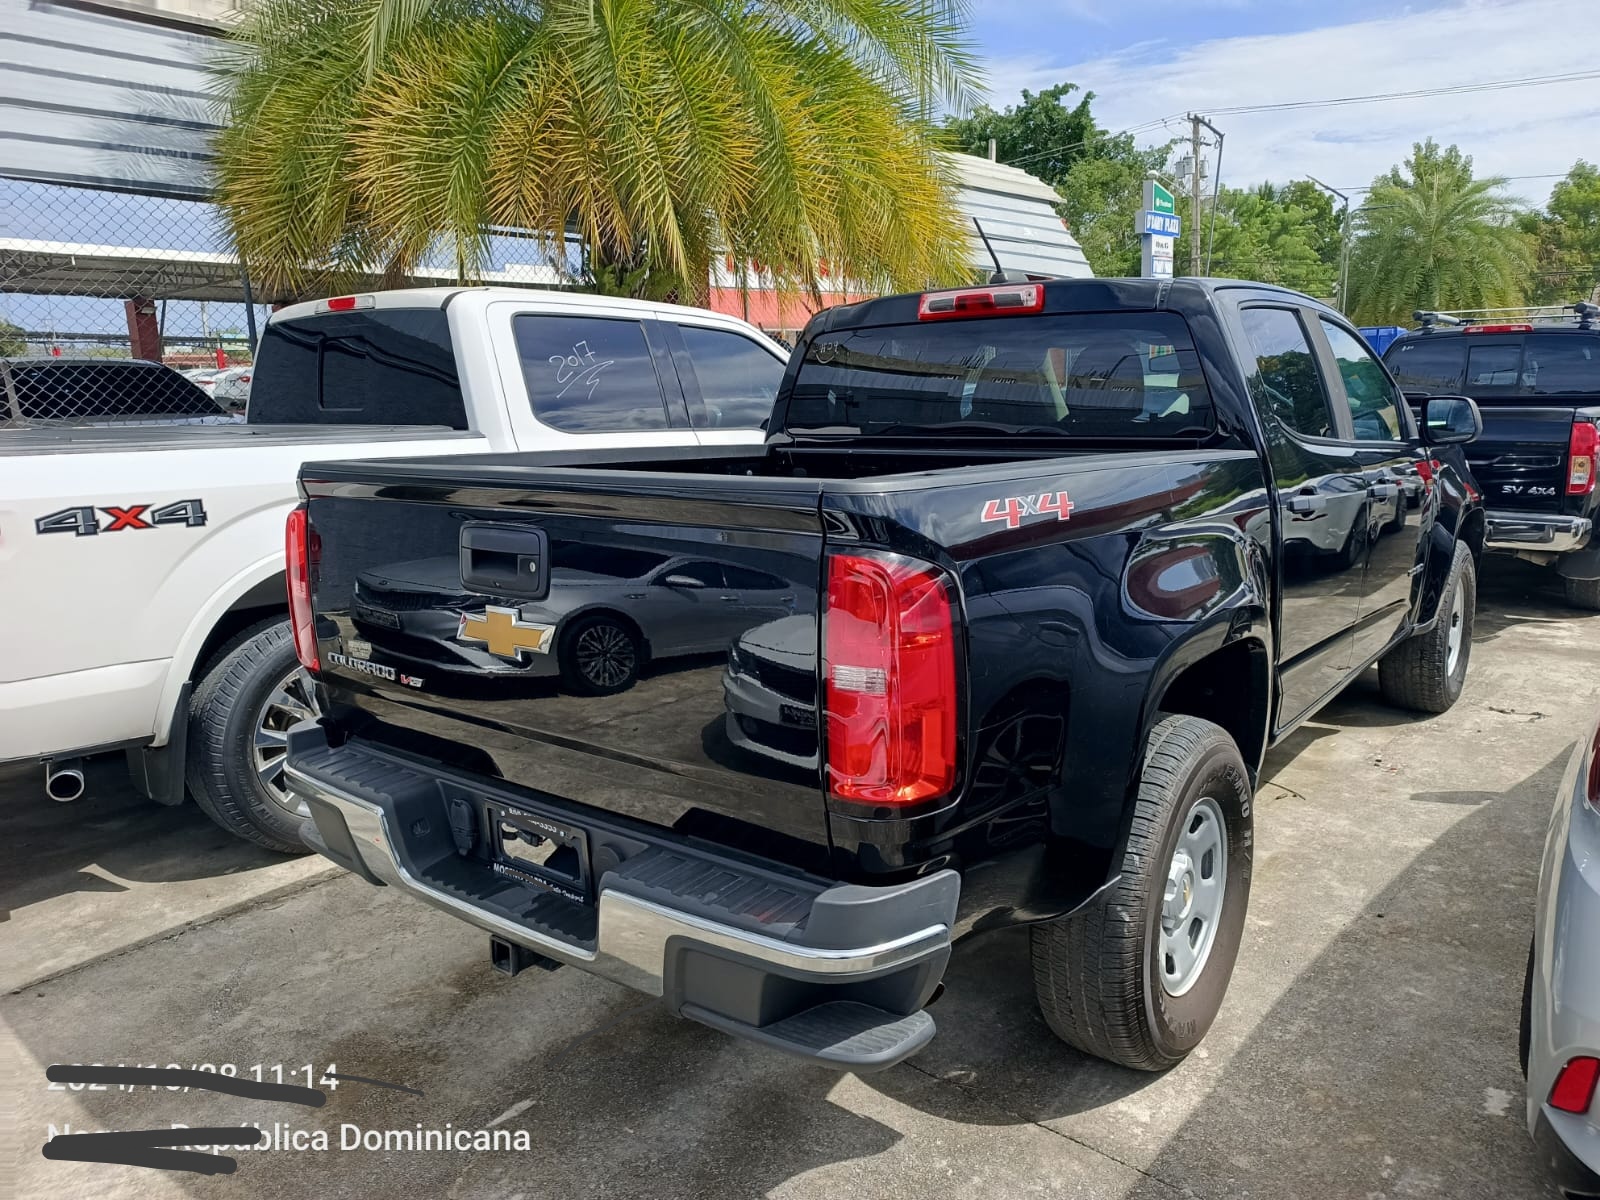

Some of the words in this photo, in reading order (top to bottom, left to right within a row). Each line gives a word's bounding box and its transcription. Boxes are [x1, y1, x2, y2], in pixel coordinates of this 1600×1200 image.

[548, 340, 596, 384] 2017
[1501, 485, 1523, 494] SV
[327, 651, 396, 681] COLORADO
